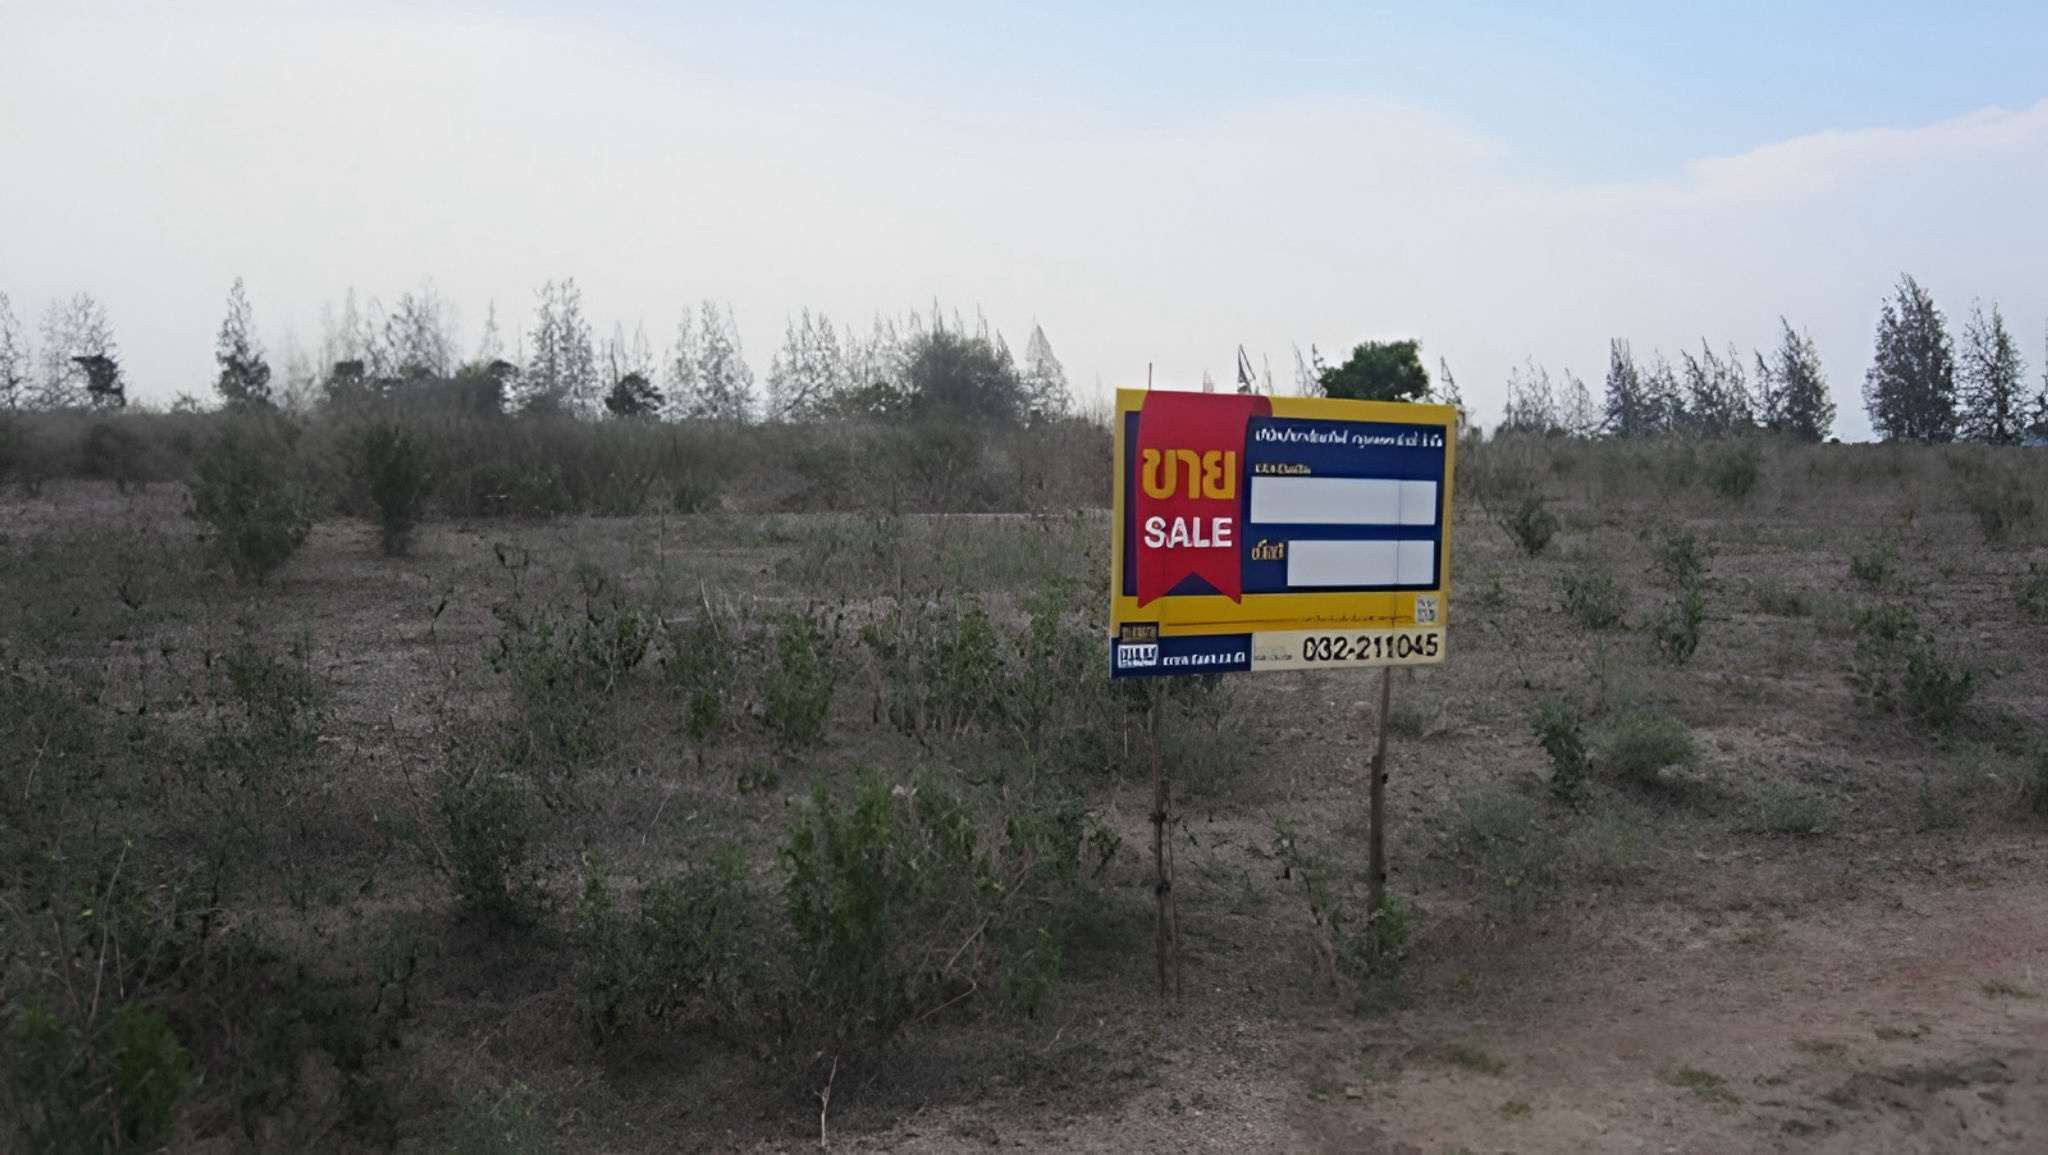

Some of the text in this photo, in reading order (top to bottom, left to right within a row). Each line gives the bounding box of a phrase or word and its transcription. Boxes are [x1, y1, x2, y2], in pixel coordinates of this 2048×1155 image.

[1142, 448, 1236, 500] ขาย
[1144, 516, 1233, 548] SALE
[1303, 633, 1438, 662] 032-211045
